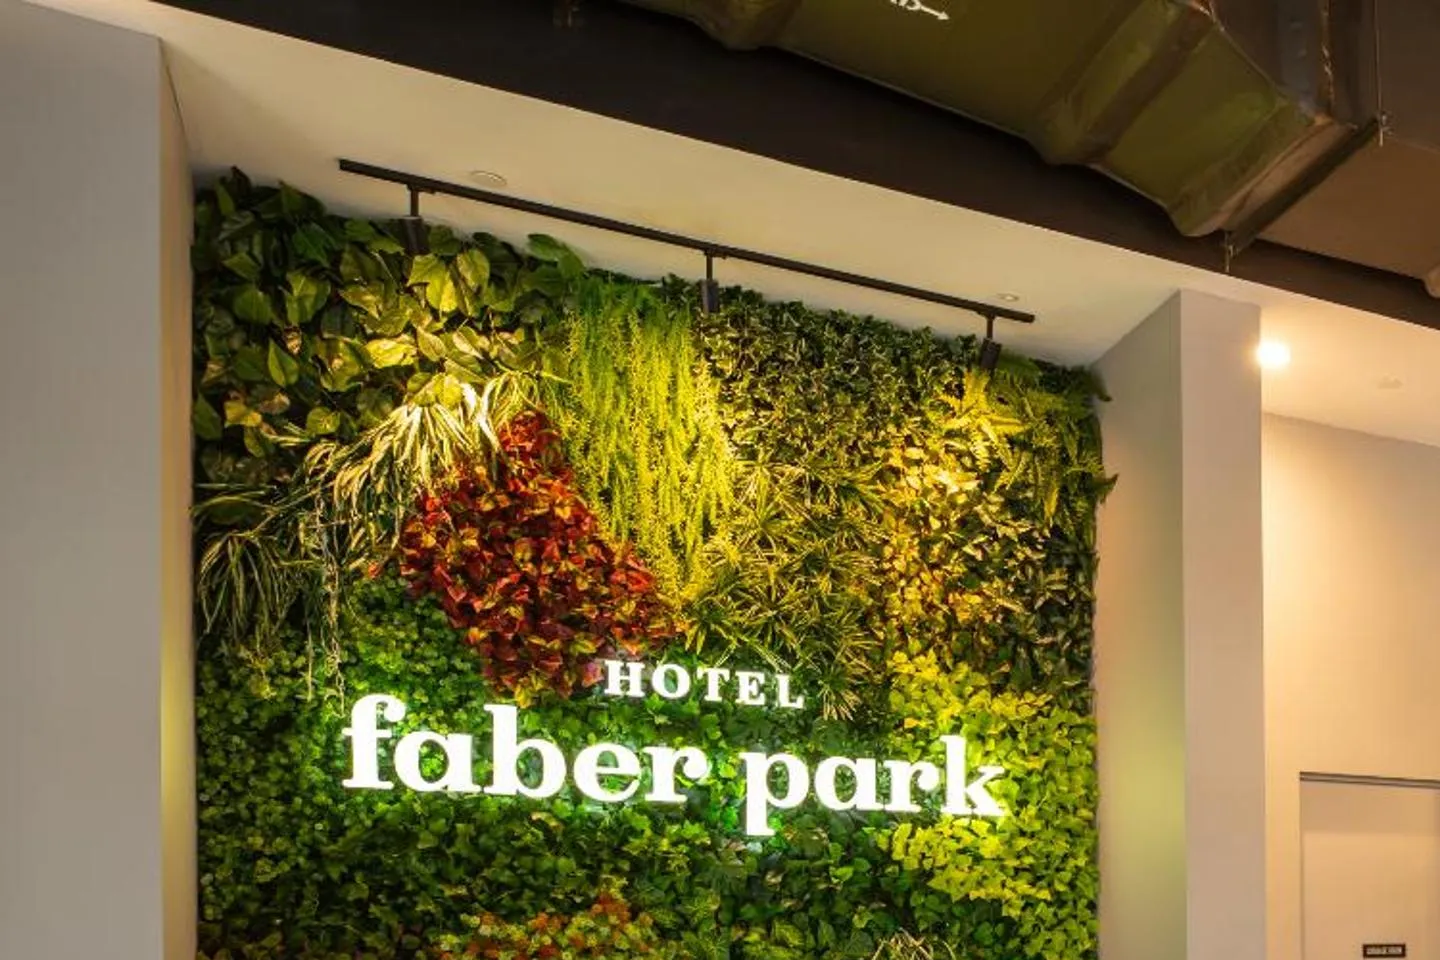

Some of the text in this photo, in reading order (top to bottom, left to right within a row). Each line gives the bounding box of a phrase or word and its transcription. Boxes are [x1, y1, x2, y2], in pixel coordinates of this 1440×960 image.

[603, 659, 805, 709] HOTEL
[342, 693, 1005, 837] faber park
